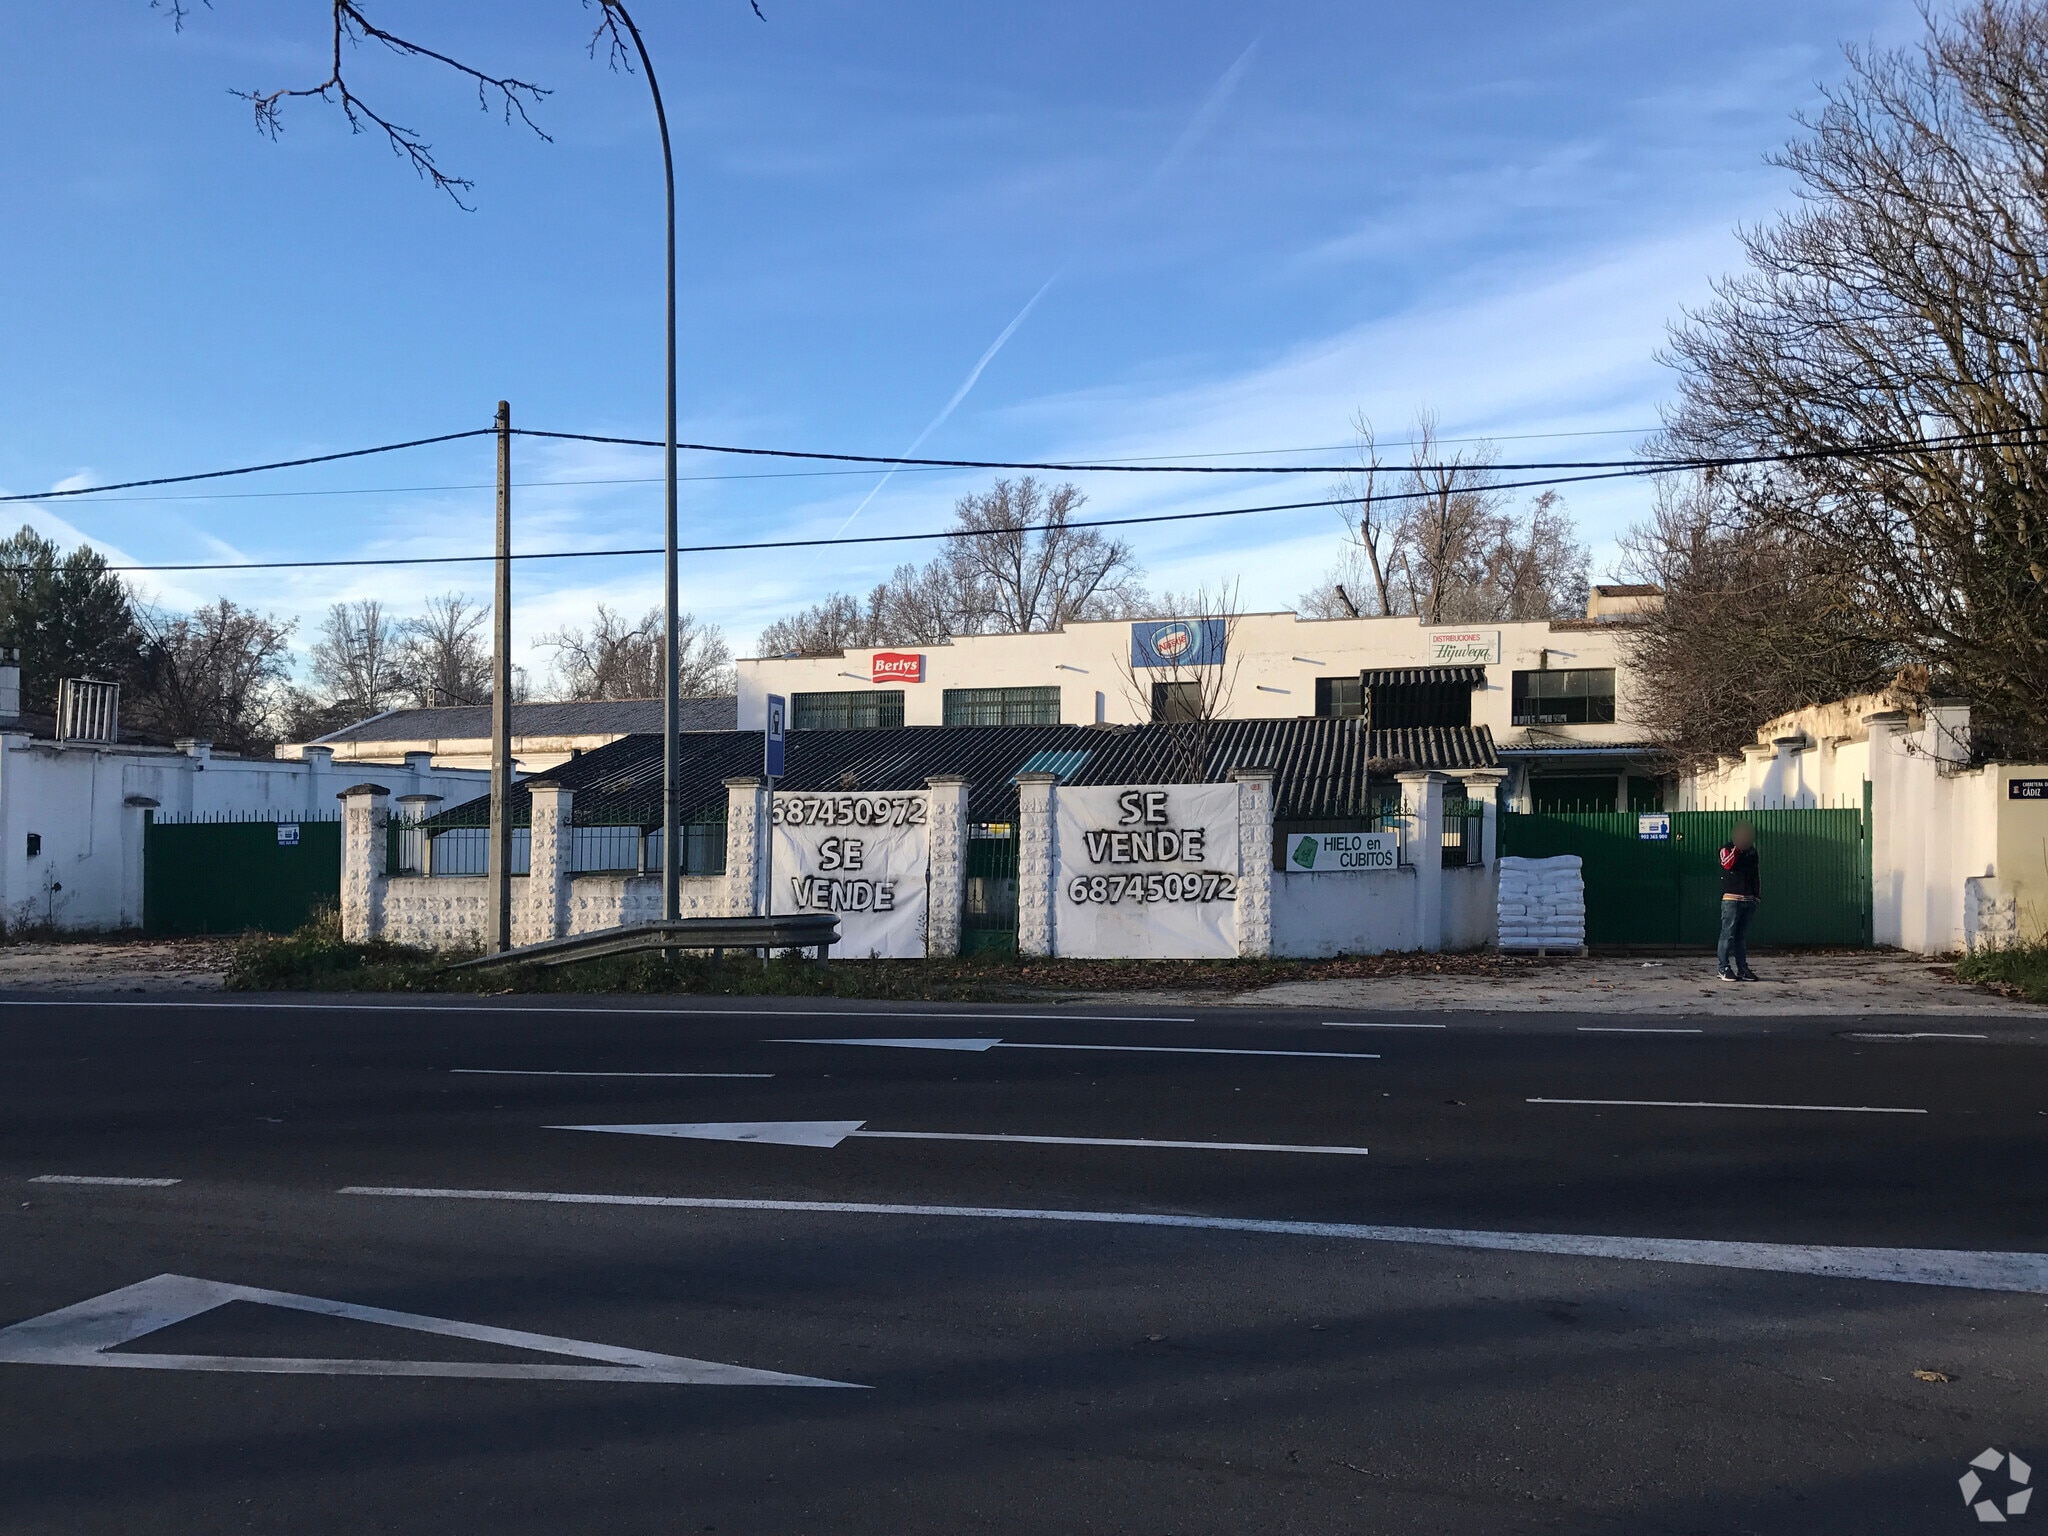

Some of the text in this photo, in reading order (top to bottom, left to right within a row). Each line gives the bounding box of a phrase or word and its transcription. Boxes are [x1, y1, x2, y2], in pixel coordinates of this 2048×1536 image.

[1433, 634, 1480, 642] DISTRIBUCIONES
[875, 659, 917, 676] Berlys
[2022, 787, 2041, 796] CÁDIZ
[772, 797, 928, 826] 687450972
[1119, 791, 1168, 825] SE
[819, 838, 864, 869] SE
[1085, 829, 1205, 863] VENDE
[1324, 836, 1380, 851] HIELO en
[1340, 851, 1393, 867] CUBITOS
[791, 876, 896, 911] VENDE
[1068, 872, 1238, 904] 687450972
